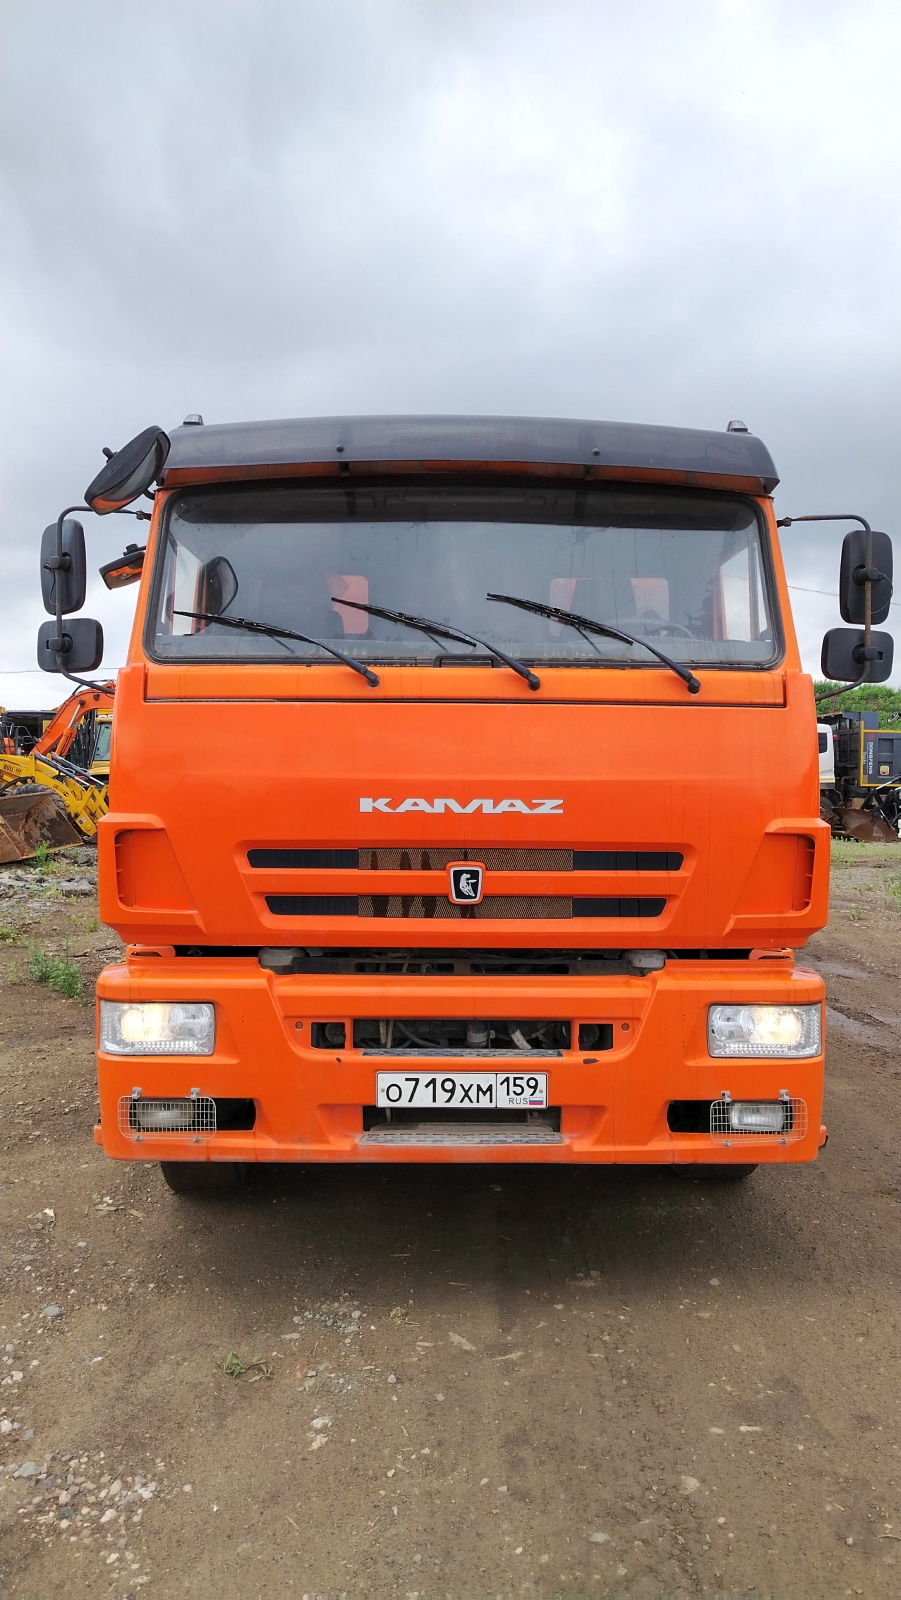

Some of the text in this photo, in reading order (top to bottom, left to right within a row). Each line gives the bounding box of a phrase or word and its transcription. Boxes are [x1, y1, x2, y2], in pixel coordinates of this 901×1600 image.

[359, 797, 564, 814] KAMAZ
[385, 1076, 539, 1104] O719XM 159
[508, 1097, 529, 1105] RUS
